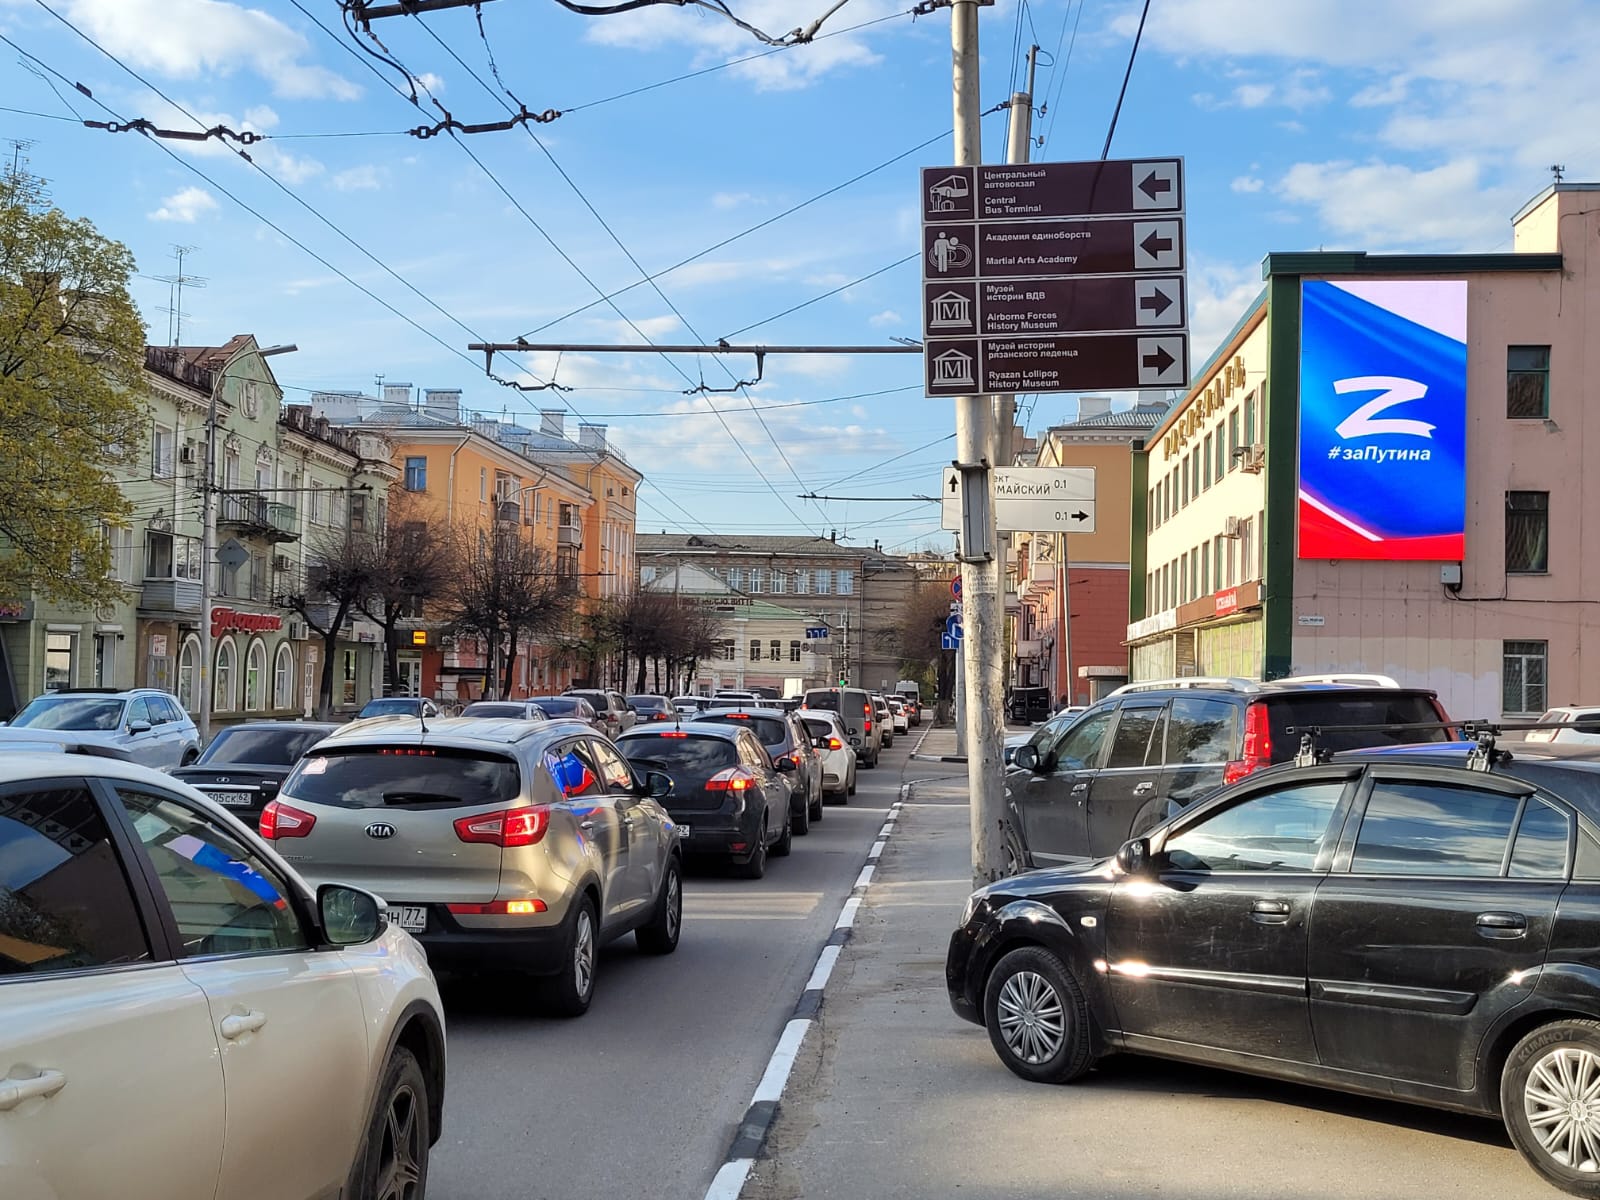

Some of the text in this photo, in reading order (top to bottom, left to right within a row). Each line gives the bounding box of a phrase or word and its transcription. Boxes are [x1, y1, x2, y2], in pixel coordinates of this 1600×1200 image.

[984, 169, 1047, 180] Центральный
[984, 180, 1035, 189] автовокзал
[985, 196, 1016, 205] Central
[985, 204, 1042, 214] Bus Terminal
[986, 230, 1092, 242] Академия единоборств
[986, 255, 1078, 265] Martial Arts Academy
[986, 285, 1014, 294] Музей
[986, 291, 1046, 302] истории ВДВ
[987, 312, 1057, 321] Airborne Forces
[987, 321, 1058, 331] History Museum
[988, 341, 1056, 352] Музей истории
[988, 348, 1079, 360] рязанского леденца
[988, 369, 1059, 380] Ryazan Lollipop
[988, 379, 1060, 389] History Museum
[1333, 376, 1437, 440] Z
[1328, 446, 1431, 464] #заПутина
[994, 482, 1051, 495] МАЙСКИЙ
[1054, 479, 1067, 489] 0.1
[1055, 511, 1068, 521] 0.1
[369, 826, 391, 836] KIA
[405, 908, 421, 921] 77
[1518, 1031, 1564, 1062] KUMHO
